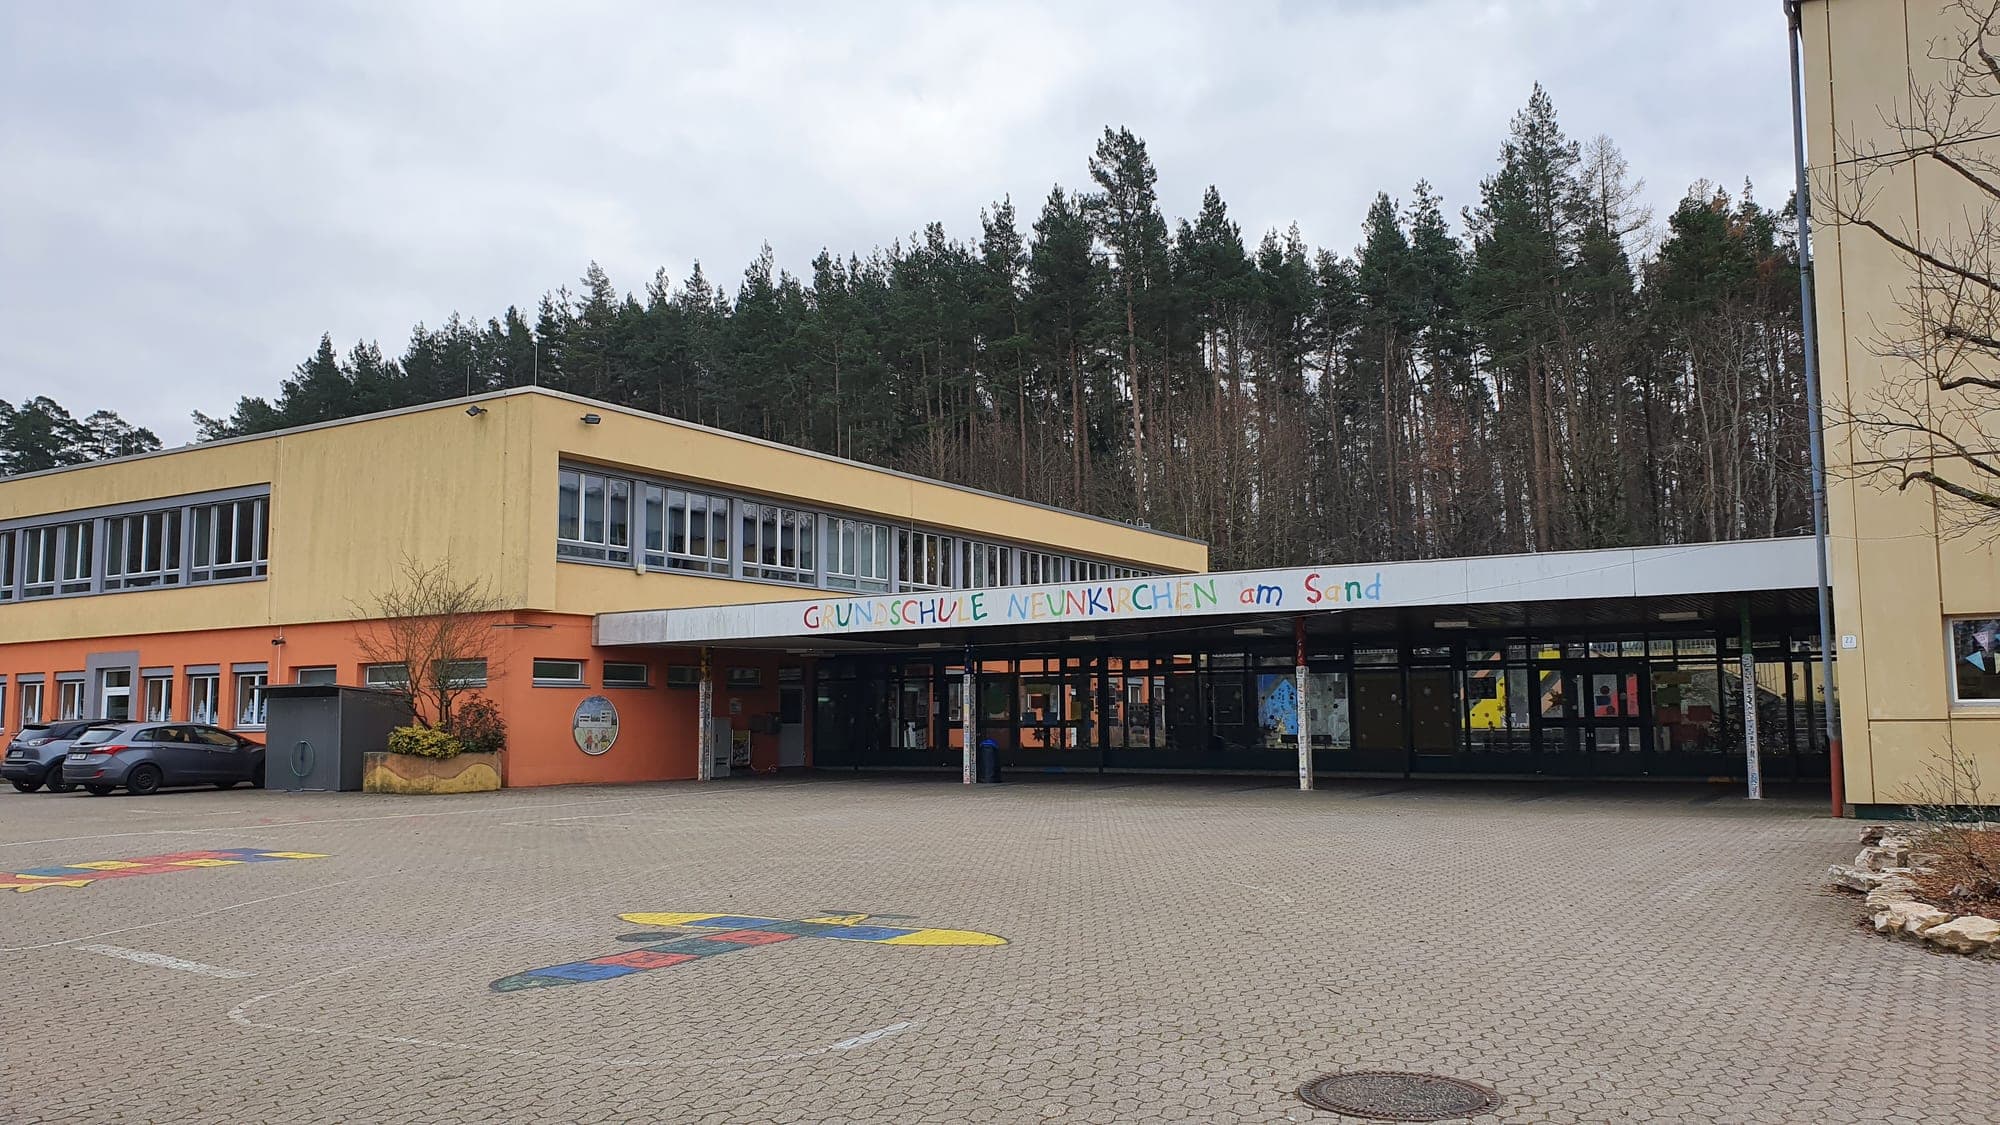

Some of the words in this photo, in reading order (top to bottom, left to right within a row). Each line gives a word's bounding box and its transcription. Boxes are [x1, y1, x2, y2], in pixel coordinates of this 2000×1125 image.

[803, 592, 988, 629] GRUNDSCHULE
[1007, 579, 1218, 620] NEUNKIRCHEN
[1239, 584, 1283, 606] am
[1303, 572, 1381, 604] Sand
